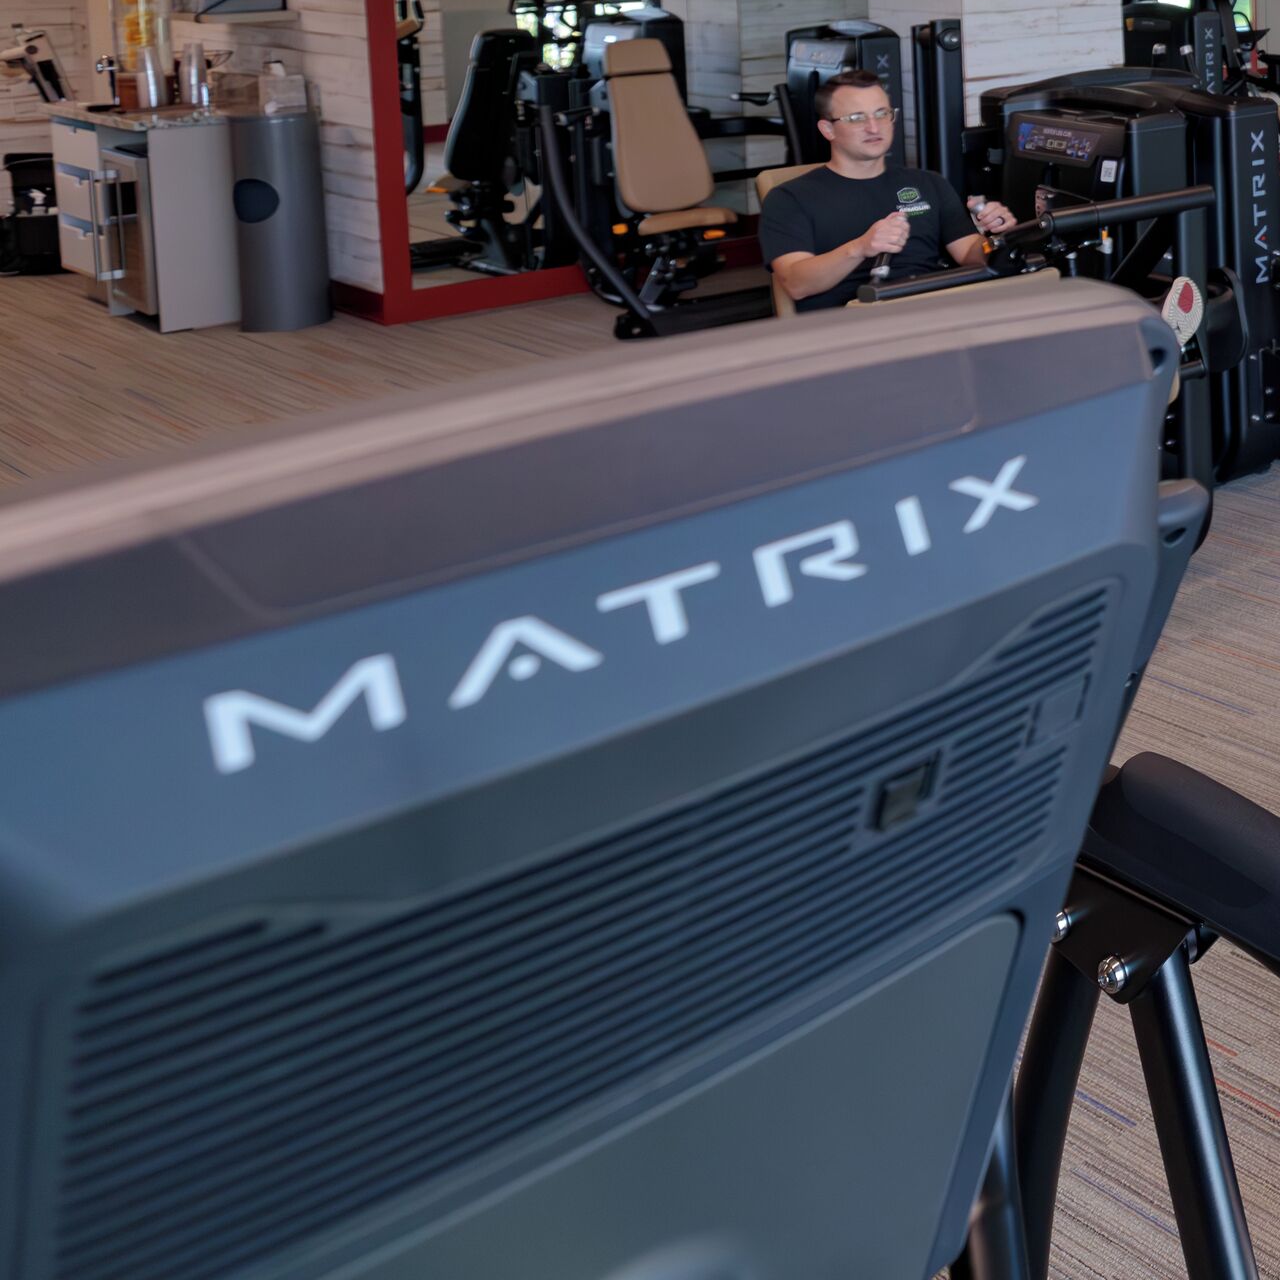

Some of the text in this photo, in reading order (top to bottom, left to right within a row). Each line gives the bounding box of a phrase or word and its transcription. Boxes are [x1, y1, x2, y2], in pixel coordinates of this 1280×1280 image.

[1204, 27, 1216, 95] ATRIX
[1250, 129, 1270, 284] MATRIX
[203, 454, 1040, 776] MATRIX
